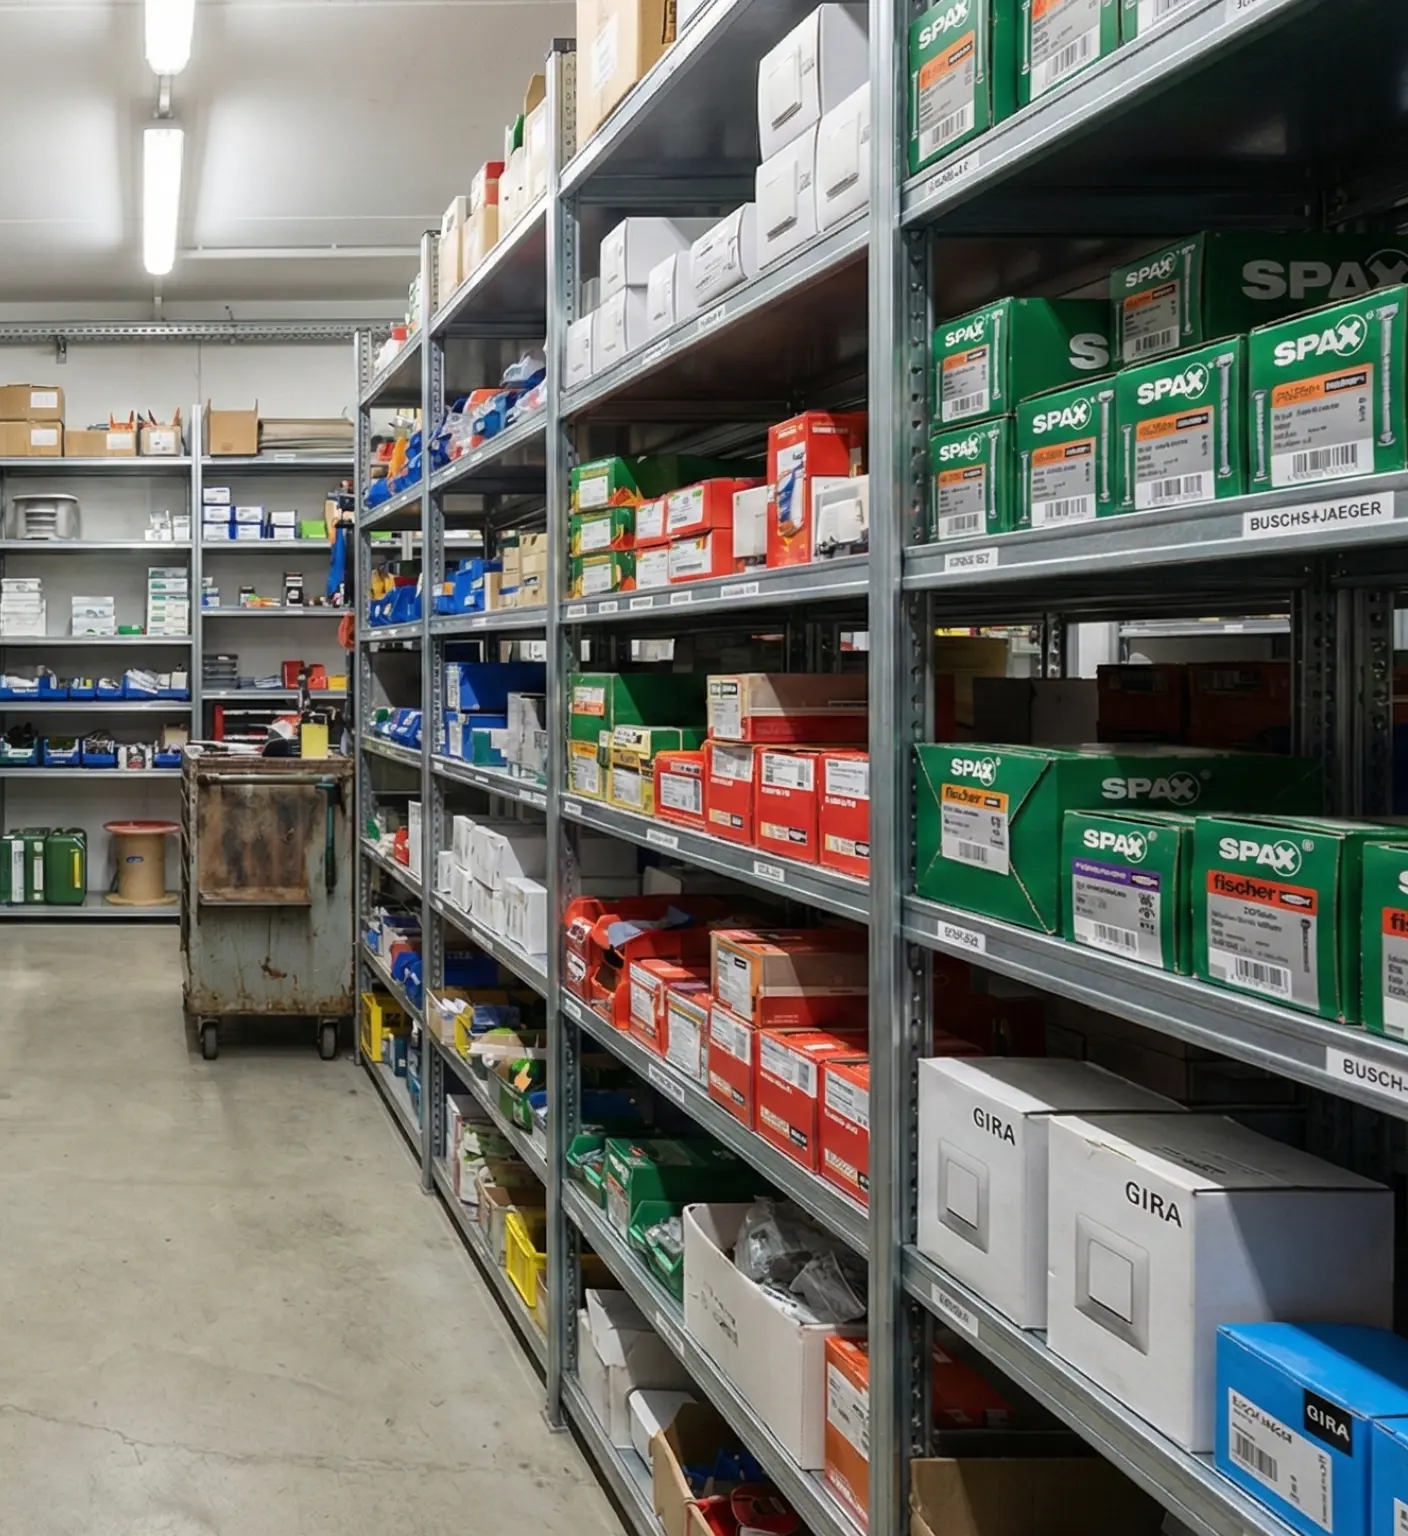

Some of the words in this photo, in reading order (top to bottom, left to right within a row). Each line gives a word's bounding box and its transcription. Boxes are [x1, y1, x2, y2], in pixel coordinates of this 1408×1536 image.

[918, 0, 968, 50] SPAX
[1125, 254, 1175, 288] SPAX
[944, 319, 985, 347] SPAX
[1273, 318, 1363, 366] SPAX
[1136, 367, 1205, 405] SPAX
[1032, 400, 1089, 434] SPAX
[939, 435, 980, 462] SPAX
[950, 757, 995, 783] SPAX
[1101, 776, 1195, 801] SPAX
[1083, 827, 1144, 859] SPAX
[1219, 836, 1299, 874] SPAX
[1214, 873, 1277, 901] fischer
[973, 1106, 1016, 1147] GIRA
[1125, 1180, 1183, 1229] GIRA
[1306, 1403, 1351, 1443] GIRA
